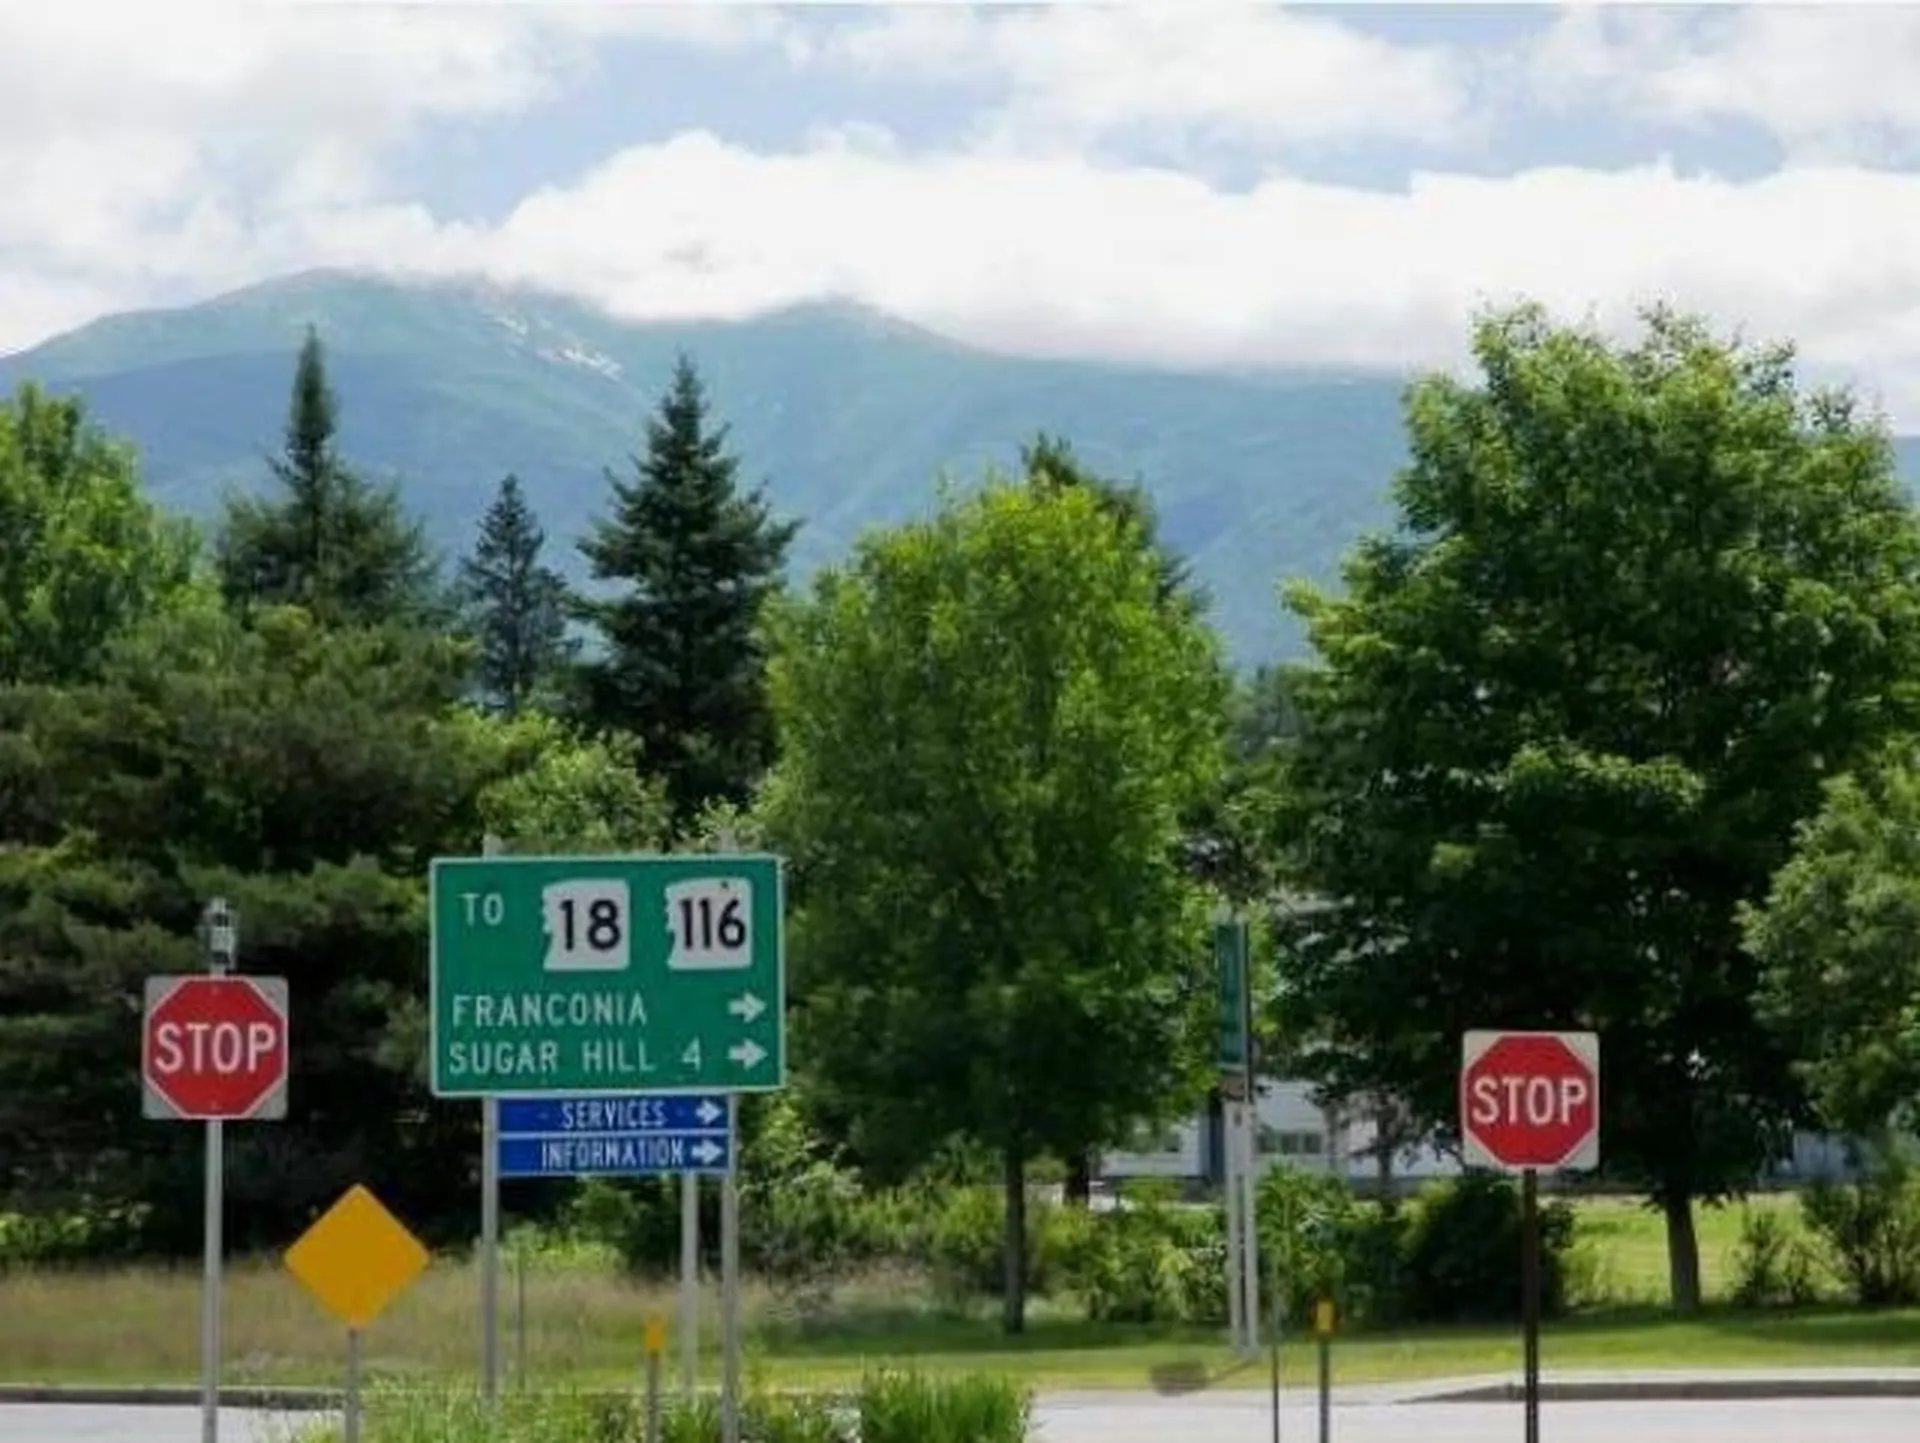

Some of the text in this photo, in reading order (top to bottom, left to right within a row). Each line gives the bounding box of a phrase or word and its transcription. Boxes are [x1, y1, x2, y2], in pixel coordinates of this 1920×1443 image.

[459, 893, 746, 952] TO 18 116
[451, 993, 649, 1028] FRANCONIA
[155, 1022, 277, 1074] STOP
[449, 1037, 702, 1076] SUGAR HILL 4
[560, 1100, 667, 1129] SERVICES
[1471, 1075, 1588, 1125] STOP
[541, 1138, 685, 1169] INFORMATION
